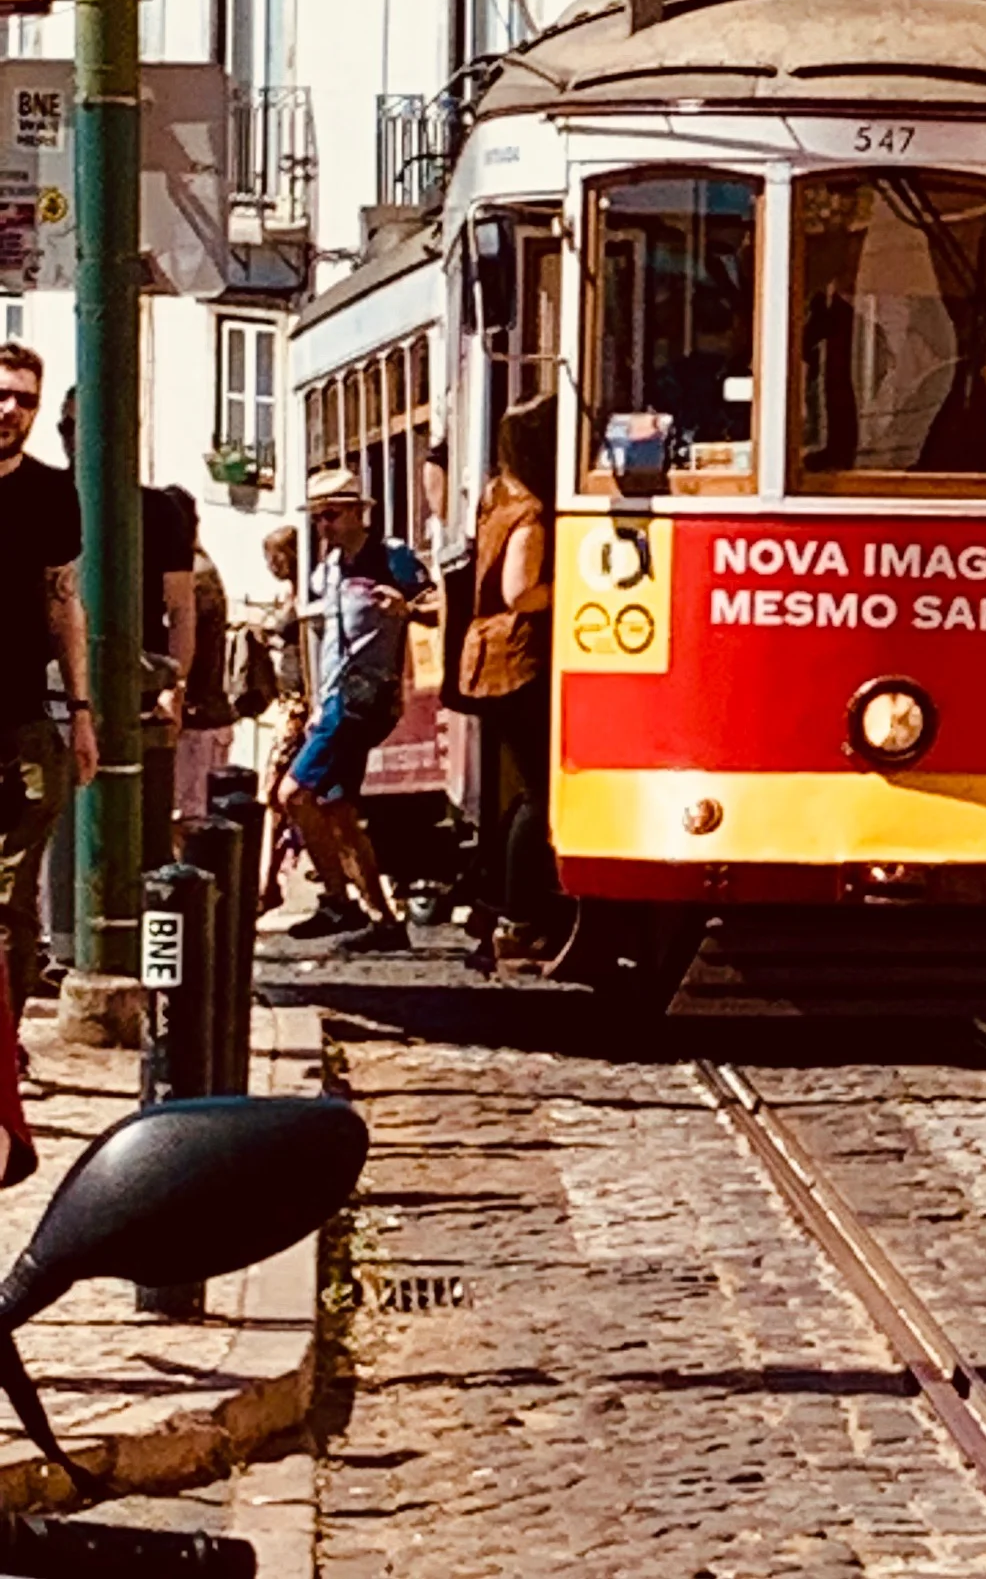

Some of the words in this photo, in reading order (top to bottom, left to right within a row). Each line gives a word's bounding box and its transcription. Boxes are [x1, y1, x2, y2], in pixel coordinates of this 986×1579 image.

[18, 91, 61, 117] BNE
[854, 127, 916, 154] 547
[714, 537, 849, 578] NOVA
[710, 588, 898, 629] MESMO
[147, 920, 177, 979] BNE
